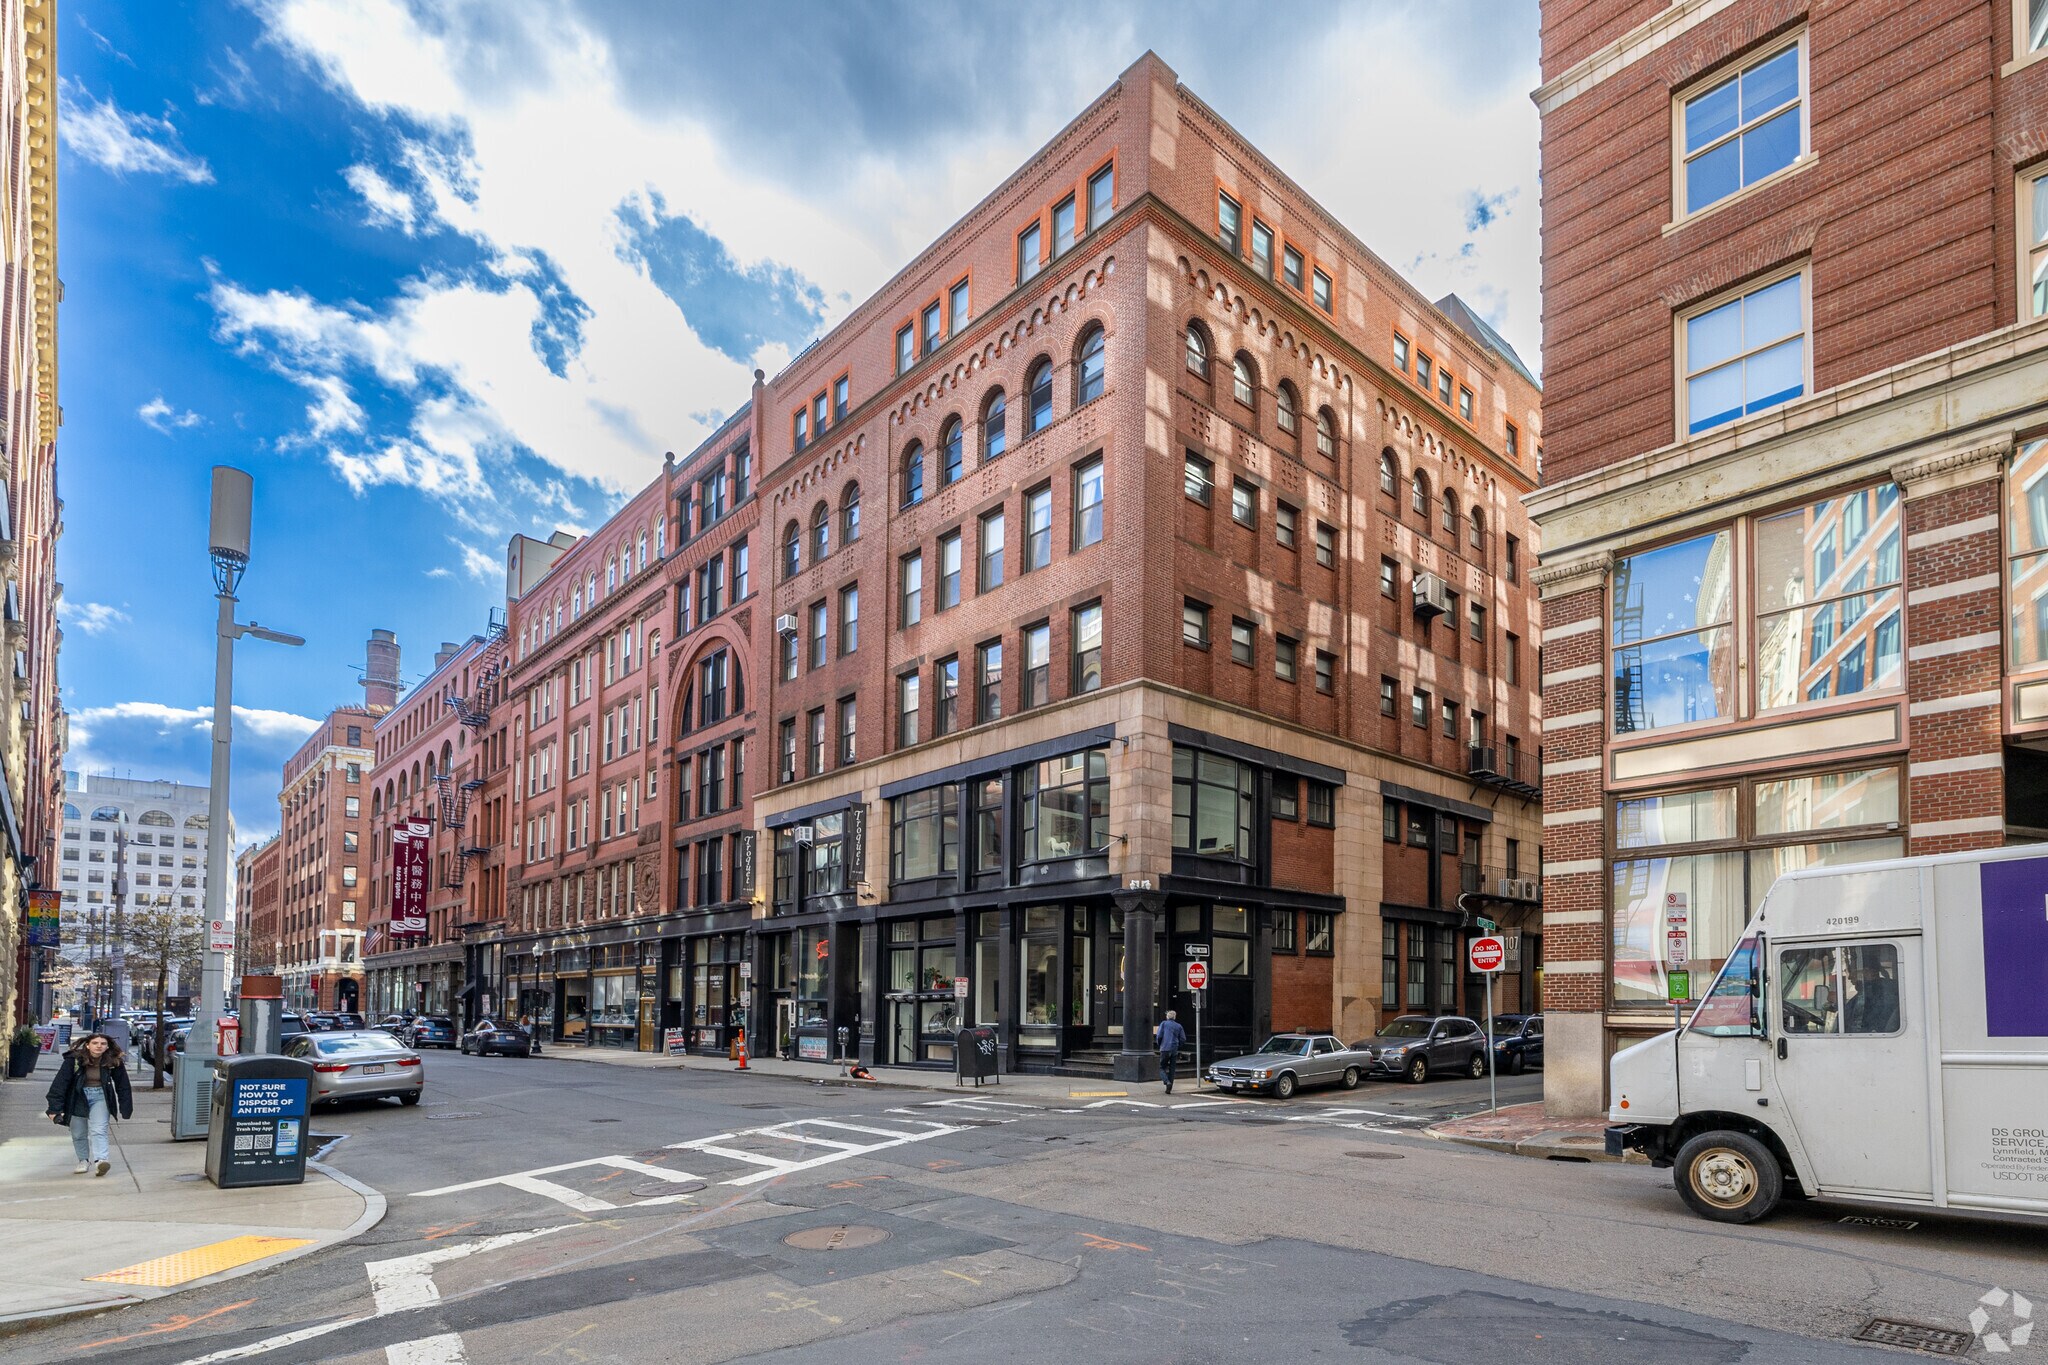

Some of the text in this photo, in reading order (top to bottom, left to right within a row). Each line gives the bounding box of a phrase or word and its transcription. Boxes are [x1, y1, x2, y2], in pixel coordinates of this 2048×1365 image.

[854, 810, 863, 865] Troquet
[744, 836, 754, 884] Troquet
[410, 840, 424, 915] 華人醫務中心
[1826, 916, 1859, 925] 420199
[1505, 936, 1518, 950] 107
[1992, 1128, 2008, 1136] DS
[1992, 1138, 2048, 1148] SERVICE,
[1993, 1148, 2037, 1156] Lynnfield,
[1993, 1155, 2041, 1163] Contracted
[1993, 1172, 2034, 1181] USDOT
